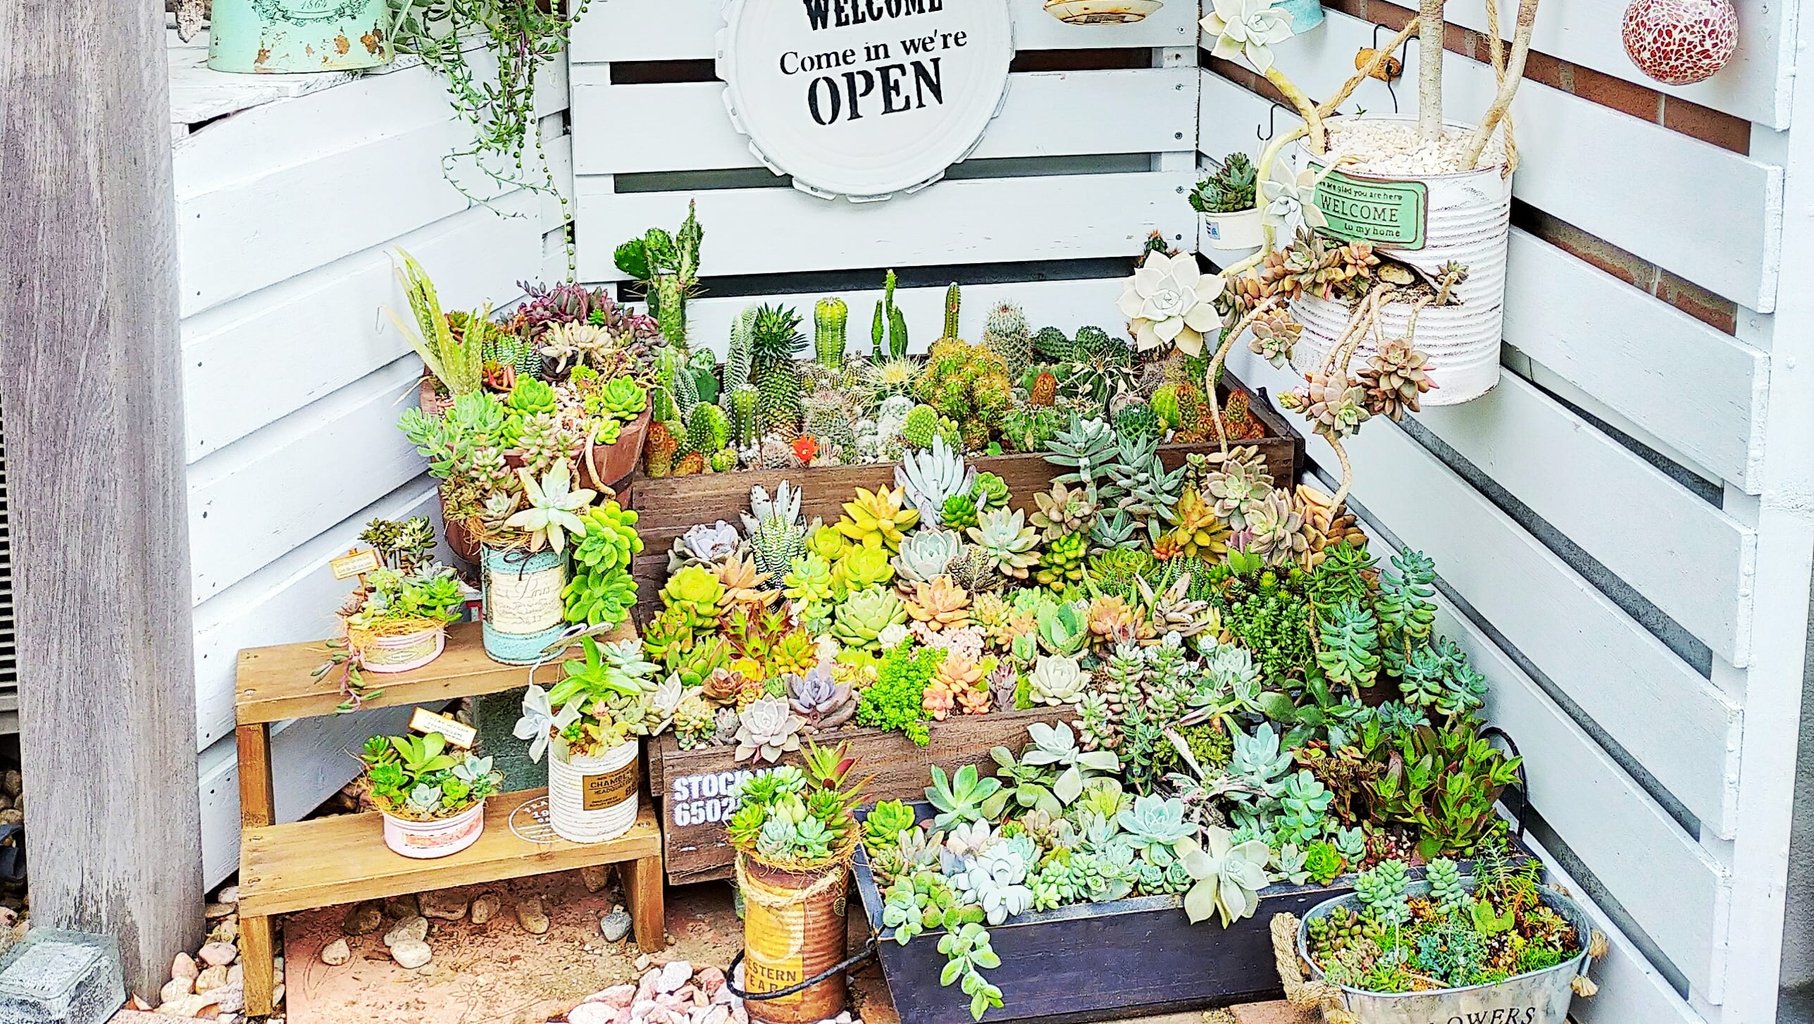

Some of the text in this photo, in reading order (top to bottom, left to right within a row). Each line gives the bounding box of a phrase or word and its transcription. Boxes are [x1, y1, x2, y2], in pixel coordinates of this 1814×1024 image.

[779, 28, 968, 75] Come in we're
[807, 57, 944, 126] OPEN
[1338, 185, 1352, 195] glad
[1353, 189, 1368, 197] you
[1383, 193, 1403, 201] here
[1320, 194, 1399, 223] WELCOME
[1344, 222, 1401, 237] to my home
[674, 798, 742, 827] 6502
